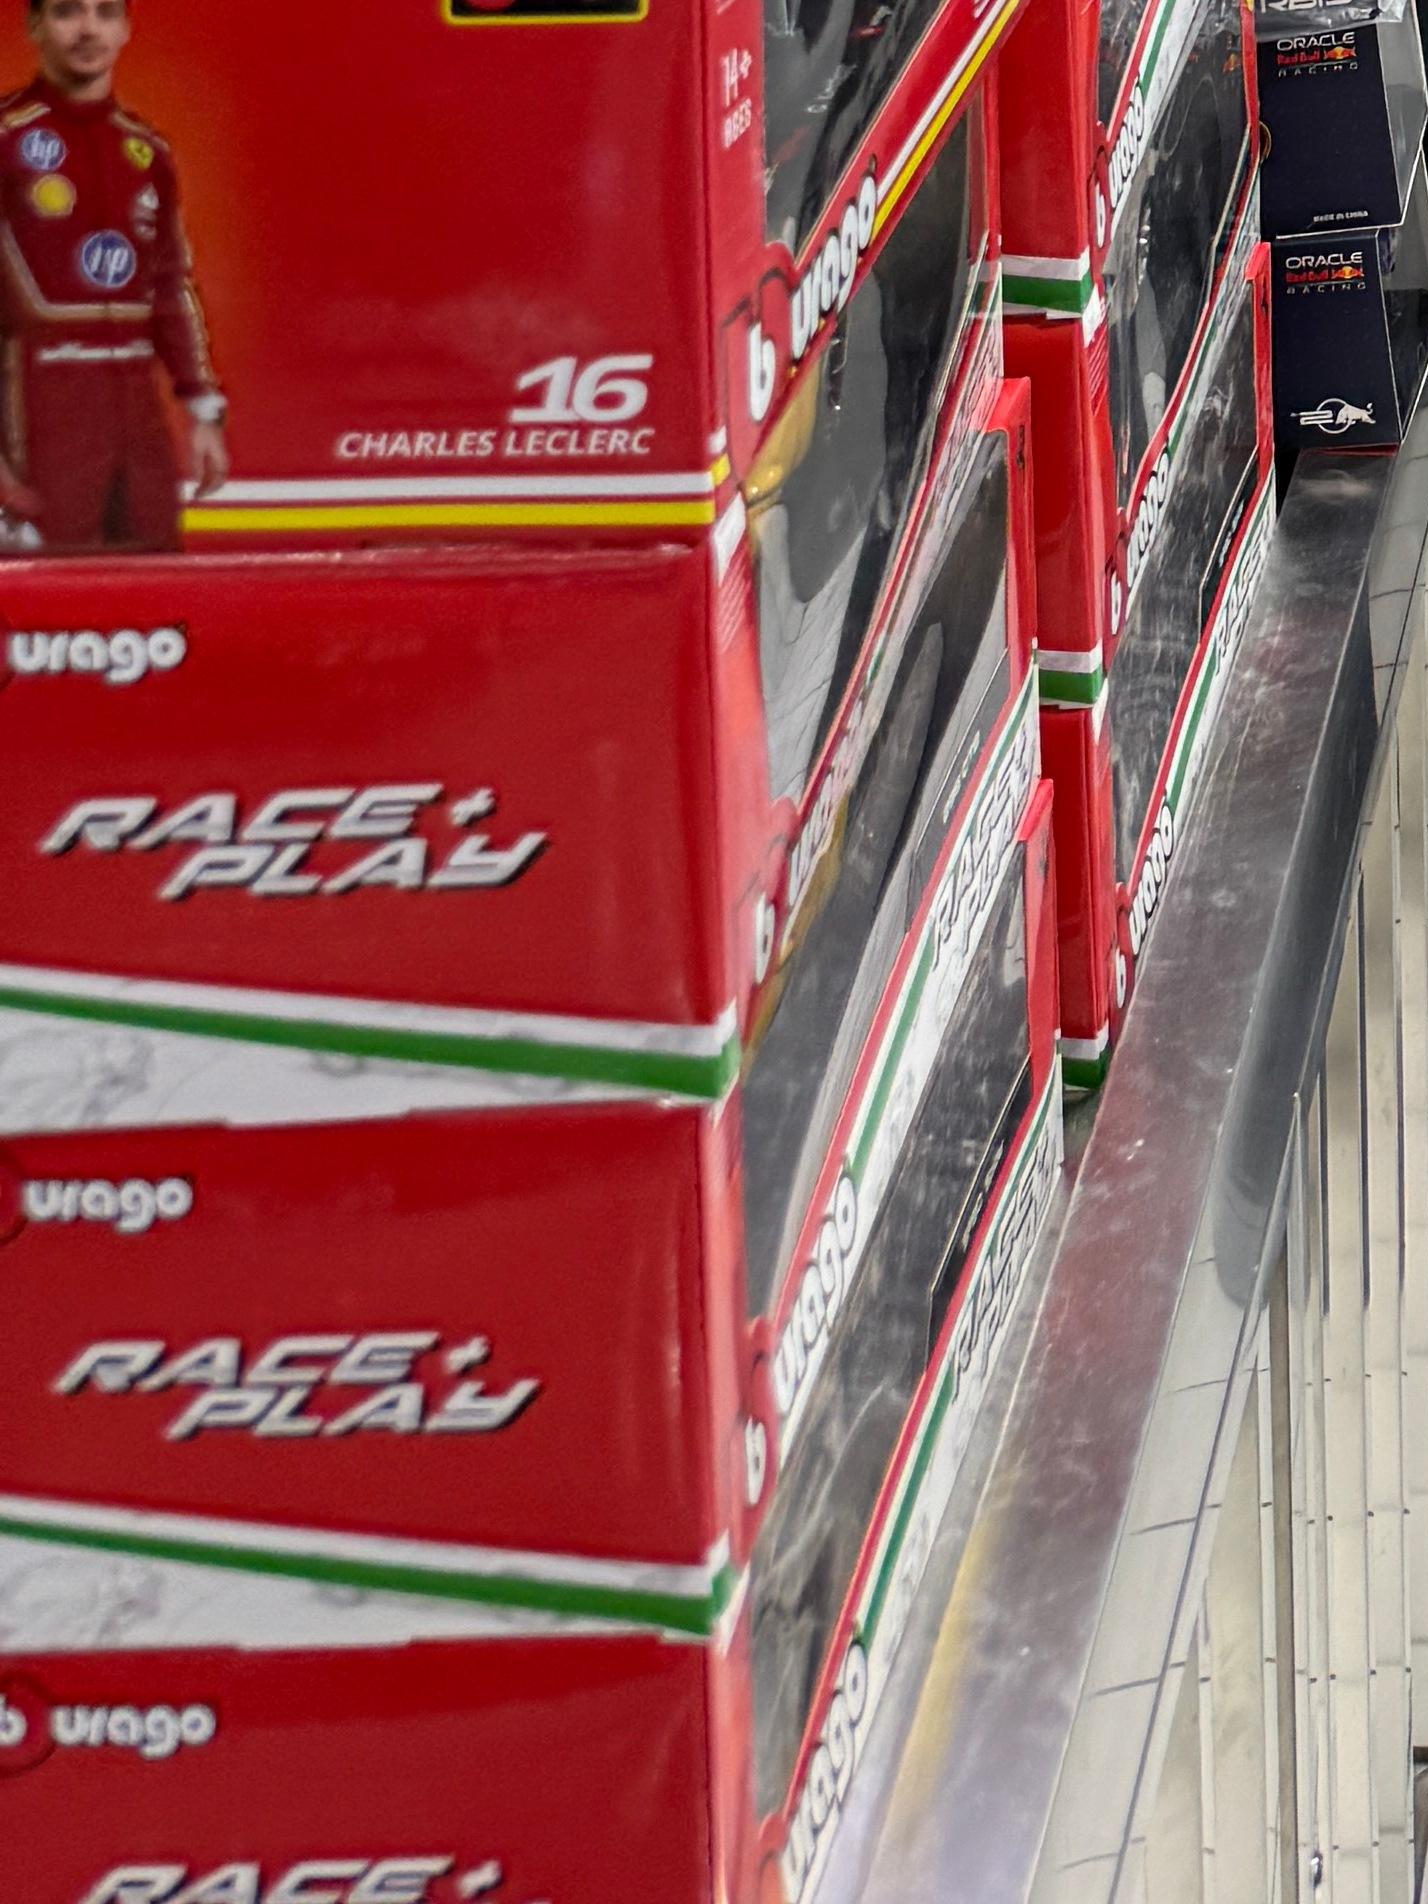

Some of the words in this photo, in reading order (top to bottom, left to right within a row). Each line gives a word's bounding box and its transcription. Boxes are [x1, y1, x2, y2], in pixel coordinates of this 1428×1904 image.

[1276, 30, 1356, 50] ORACLE
[1277, 61, 1358, 78] RACING
[1284, 251, 1364, 268] ORACLE
[1286, 281, 1367, 294] RACING
[745, 174, 878, 422] burago
[508, 354, 655, 424] 16
[336, 429, 496, 460] CHARLES
[501, 428, 656, 457] LECLERC
[40, 784, 442, 855] RACE
[156, 830, 548, 903] PLAY
[54, 1330, 440, 1394] RACE
[163, 1377, 541, 1441] PLAY
[78, 1856, 455, 1904] RACE
